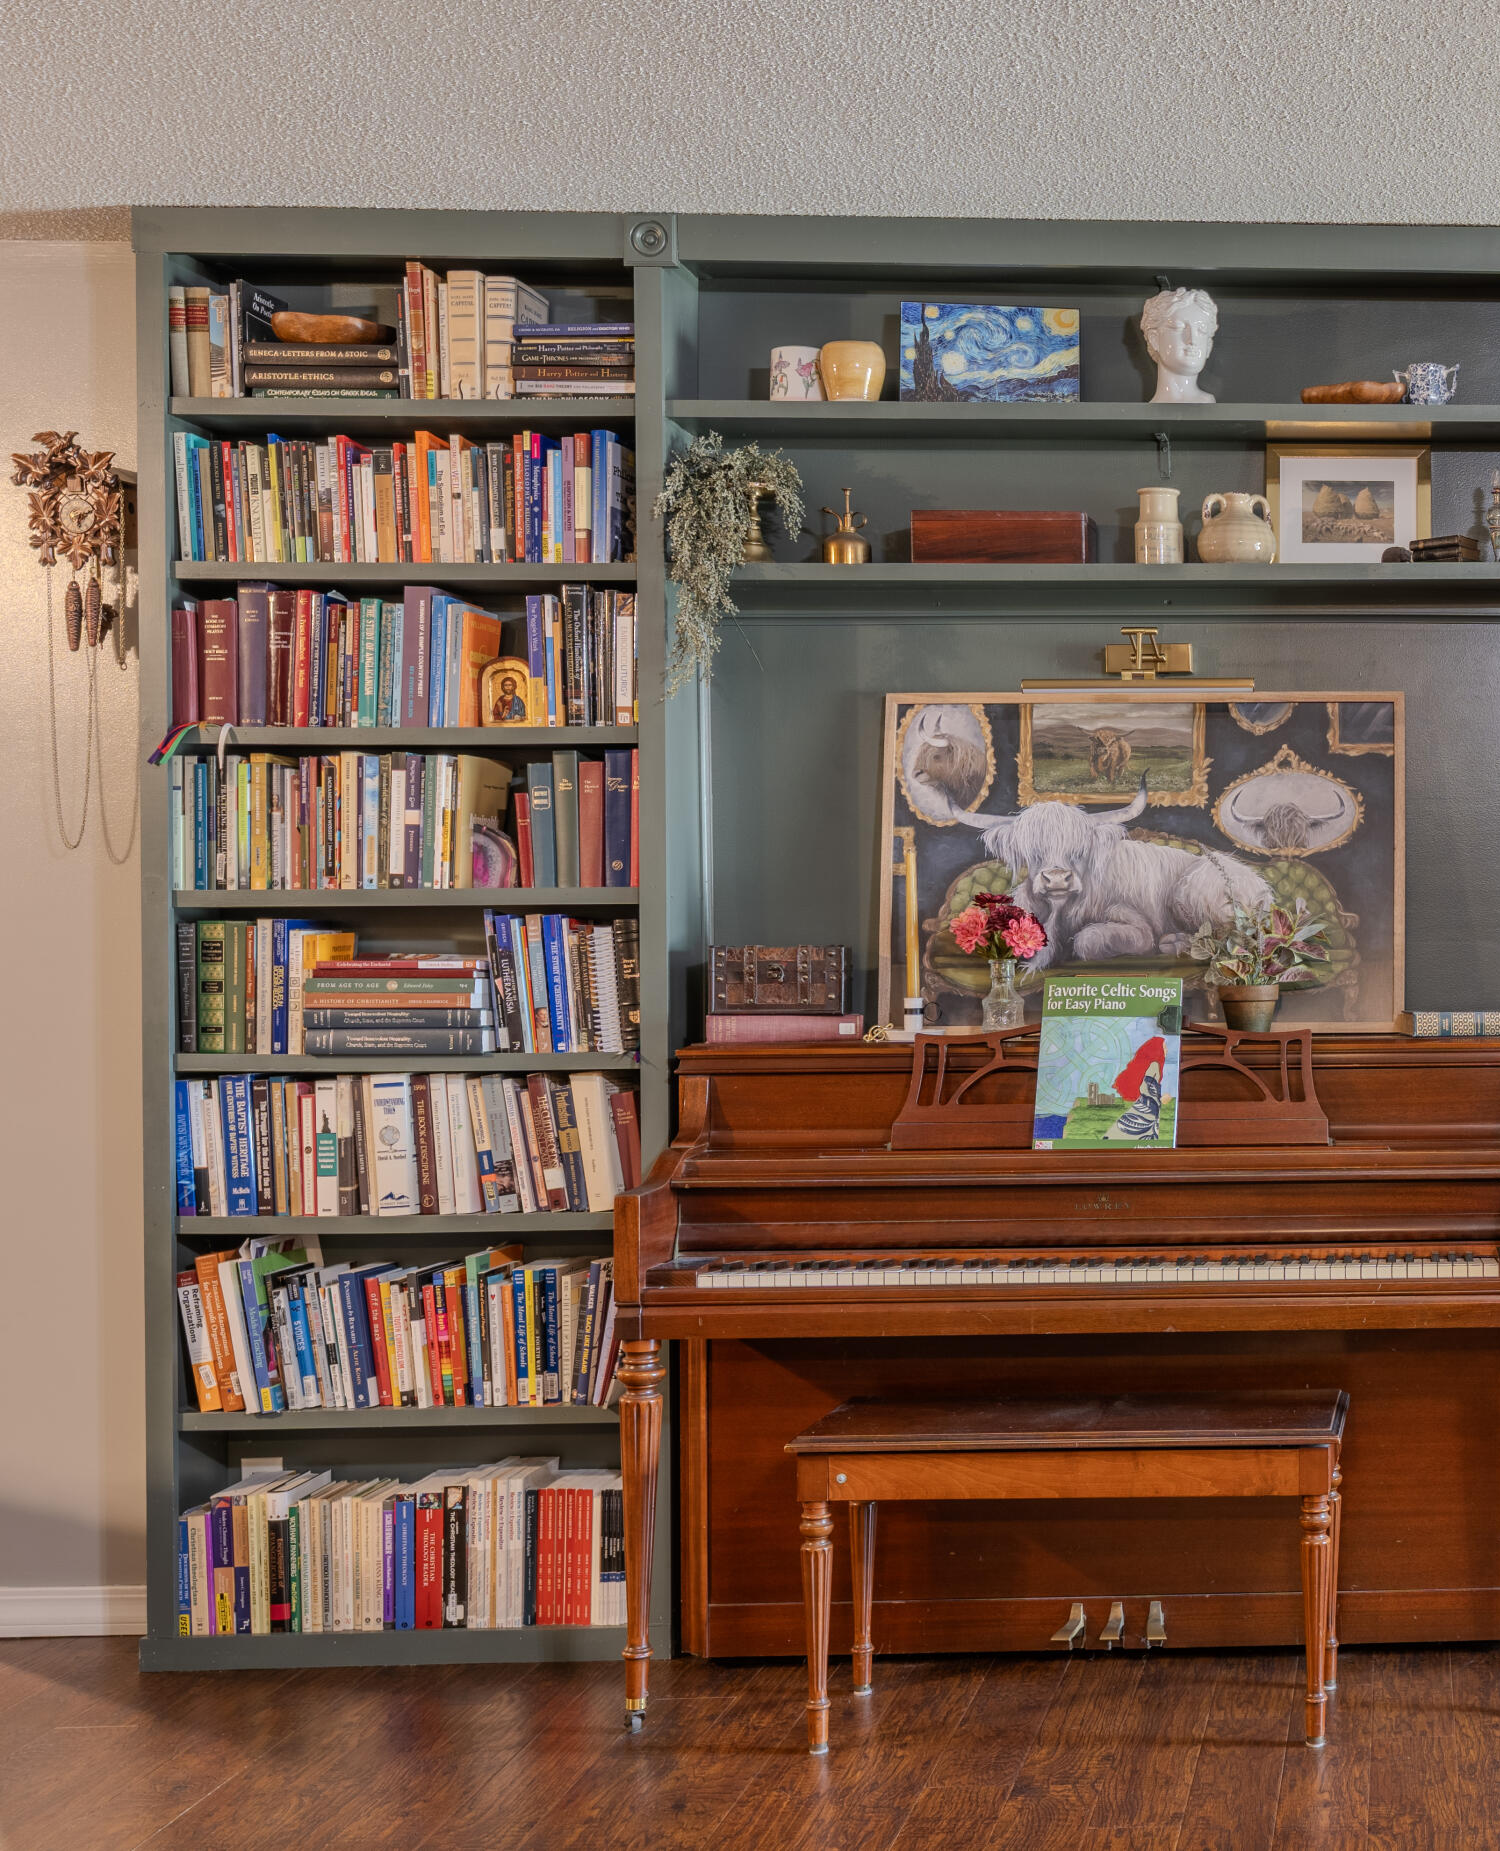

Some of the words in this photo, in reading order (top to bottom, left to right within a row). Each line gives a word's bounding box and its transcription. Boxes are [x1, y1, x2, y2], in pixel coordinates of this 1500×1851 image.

[338, 349, 344, 359] A
[346, 349, 368, 359] STOIC
[532, 466, 540, 501] Metaphysics
[437, 483, 445, 515] Symbolism
[366, 605, 374, 617] THE
[366, 619, 374, 640] STUDY
[366, 642, 374, 650] OF
[366, 652, 374, 695] ANGLICANISM
[550, 941, 558, 955] THE
[551, 956, 559, 973] STORY
[502, 959, 514, 1014] LUTHERANISM
[1048, 984, 1097, 997] Favorite
[1102, 983, 1136, 997] Celtic
[1139, 984, 1177, 1002] Songs
[553, 984, 563, 1031] CHRISTIANITY
[1047, 999, 1062, 1009] for
[1066, 999, 1091, 1012] Easy
[1094, 998, 1126, 1010] Piano
[236, 1081, 245, 1098] THE
[237, 1102, 247, 1134] BAPTIST
[417, 1101, 425, 1113] THE
[418, 1115, 426, 1137] BOOK
[238, 1138, 249, 1177] HERITAGE
[420, 1145, 430, 1185] DISCIPLINE
[203, 1282, 212, 1292] for
[211, 1280, 224, 1311] Financial
[343, 1280, 354, 1310] PUNISHED
[517, 1292, 525, 1302] The
[587, 1284, 596, 1309] WALKER
[190, 1288, 204, 1328] Reframing
[205, 1292, 217, 1323] Nonprofit
[370, 1293, 378, 1307] off
[181, 1290, 198, 1343] Organizations
[249, 1307, 260, 1328] Models
[371, 1310, 380, 1322] the
[517, 1304, 525, 1322] Moral
[584, 1314, 593, 1334] TEACH
[216, 1312, 230, 1357] Management
[295, 1327, 306, 1351] VOICES
[347, 1318, 358, 1343] REWARDS
[372, 1325, 381, 1341] mark
[518, 1324, 526, 1336] Life
[209, 1324, 223, 1369] Organizations
[252, 1337, 264, 1368] Teaching
[583, 1336, 591, 1347] LIKE
[518, 1345, 527, 1367] Schools
[581, 1349, 590, 1374] FINLAND
[353, 1367, 363, 1384] KOHN
